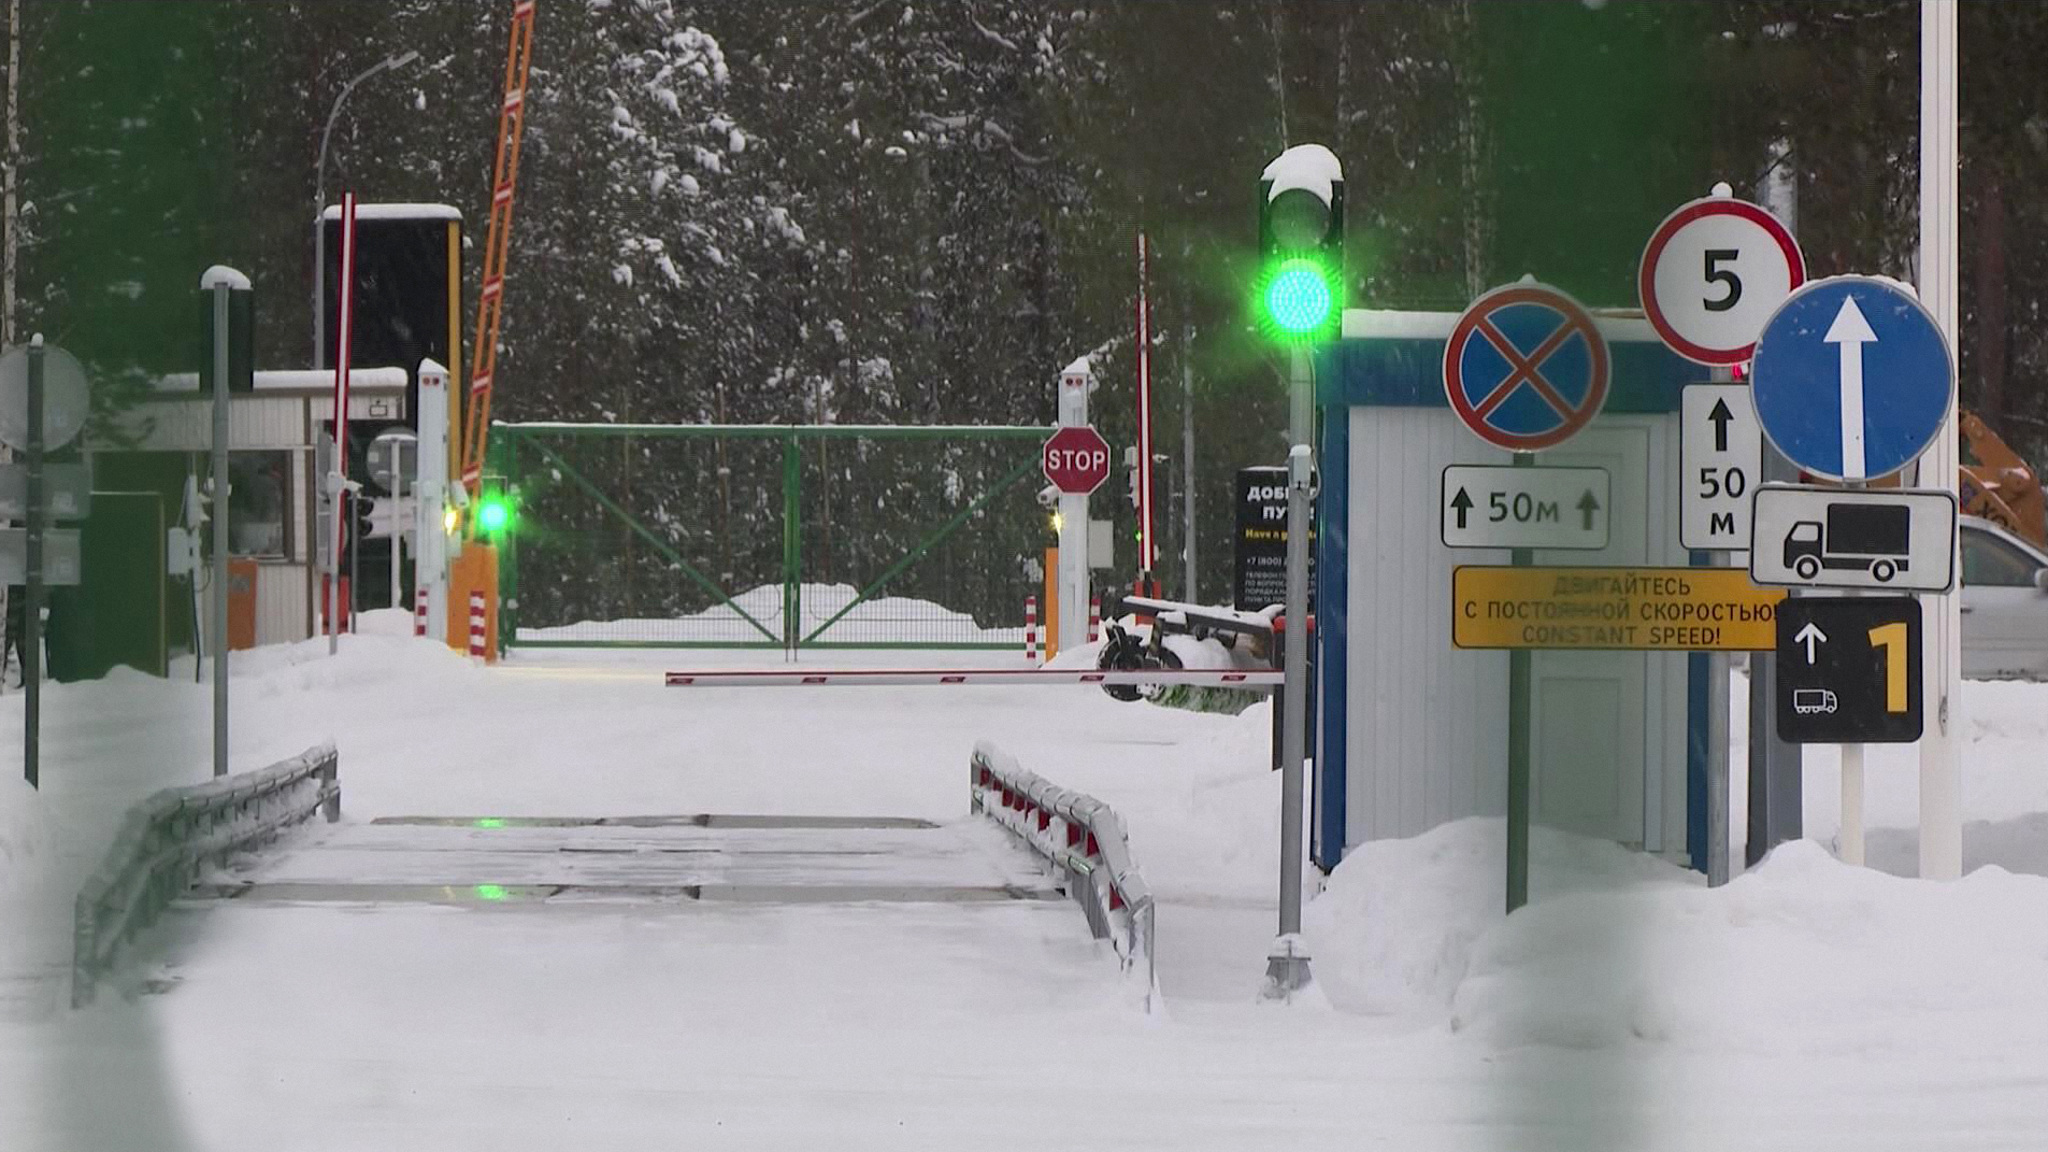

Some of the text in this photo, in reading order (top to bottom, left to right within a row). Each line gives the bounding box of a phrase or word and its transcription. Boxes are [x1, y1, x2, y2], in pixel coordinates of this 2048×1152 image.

[1703, 249, 1742, 311] 5
[1048, 449, 1106, 471] STOP
[1699, 467, 1746, 499] 50
[1465, 602, 1477, 618] С
[1522, 625, 1721, 645] CONSTANT SPEED!
[1868, 622, 1908, 712] 1
